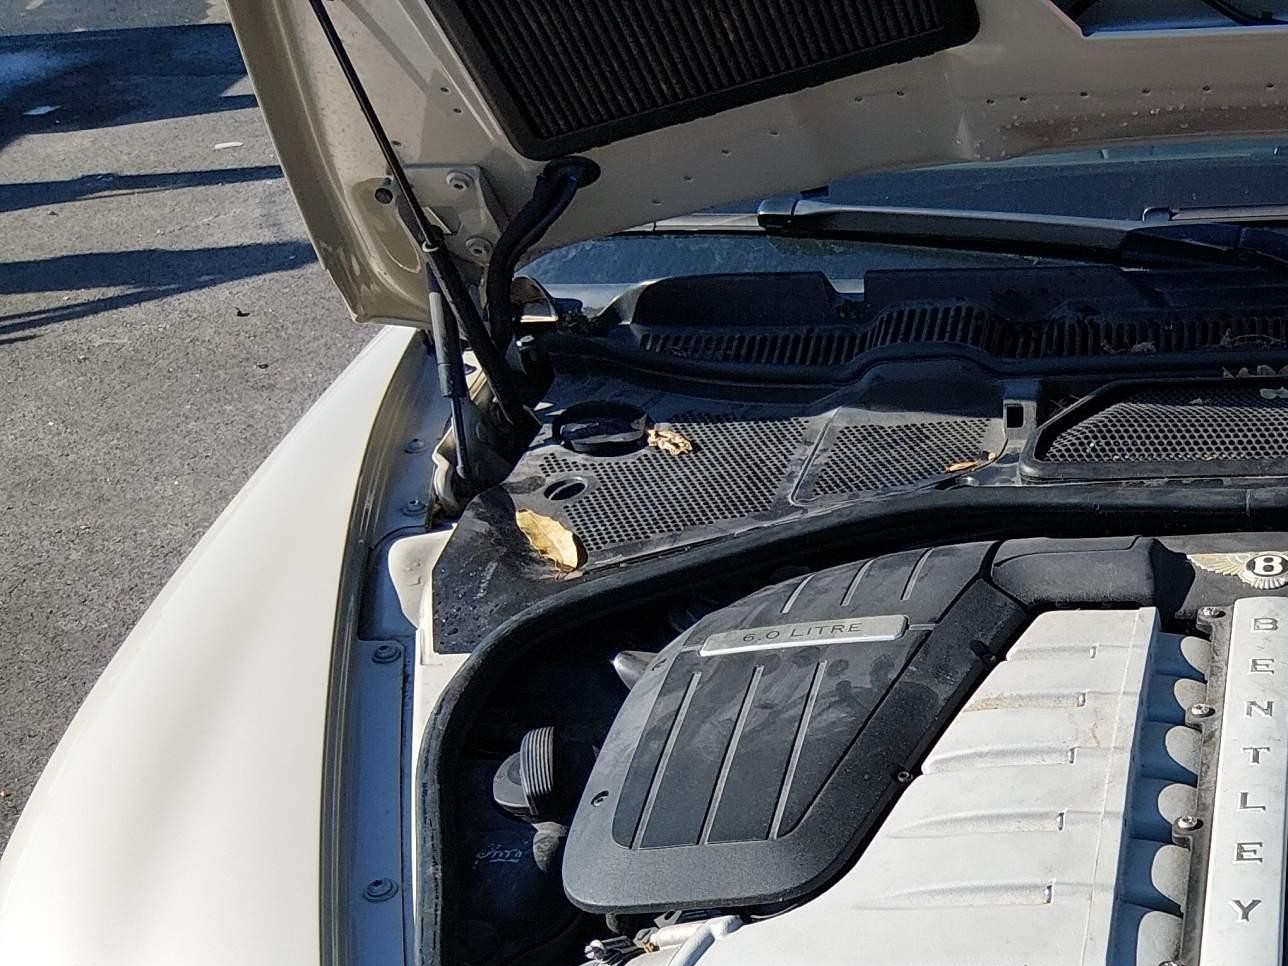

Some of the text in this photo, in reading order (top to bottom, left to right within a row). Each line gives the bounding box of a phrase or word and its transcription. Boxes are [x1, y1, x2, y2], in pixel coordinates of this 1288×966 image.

[743, 622, 862, 642] 6.0 LITRE
[1232, 617, 1279, 922] BENTLEY
